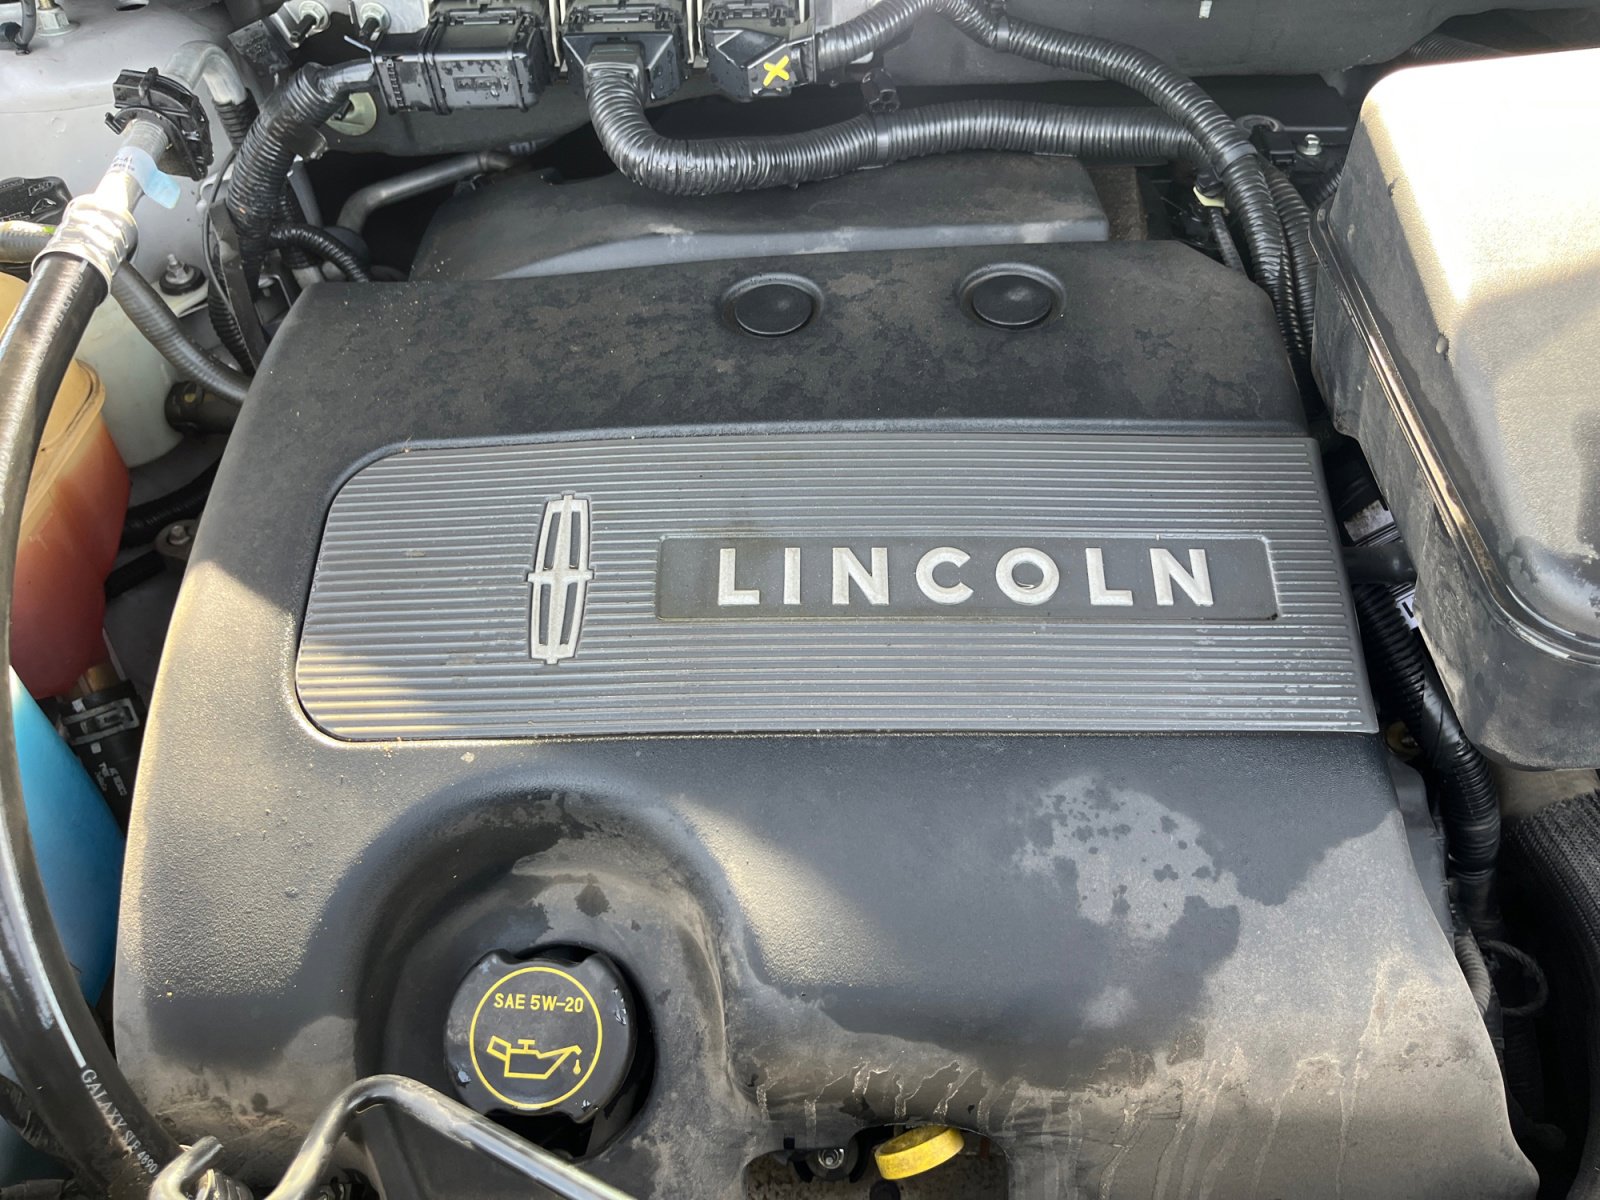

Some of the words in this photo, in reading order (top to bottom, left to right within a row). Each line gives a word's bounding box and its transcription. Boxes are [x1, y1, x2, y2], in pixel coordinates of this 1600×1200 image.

[717, 547, 1214, 607] LINCOLN
[493, 992, 526, 1010] SAE
[529, 994, 584, 1013] 5W-20
[81, 1069, 127, 1131] GALAXY
[137, 1150, 158, 1174] 4890
